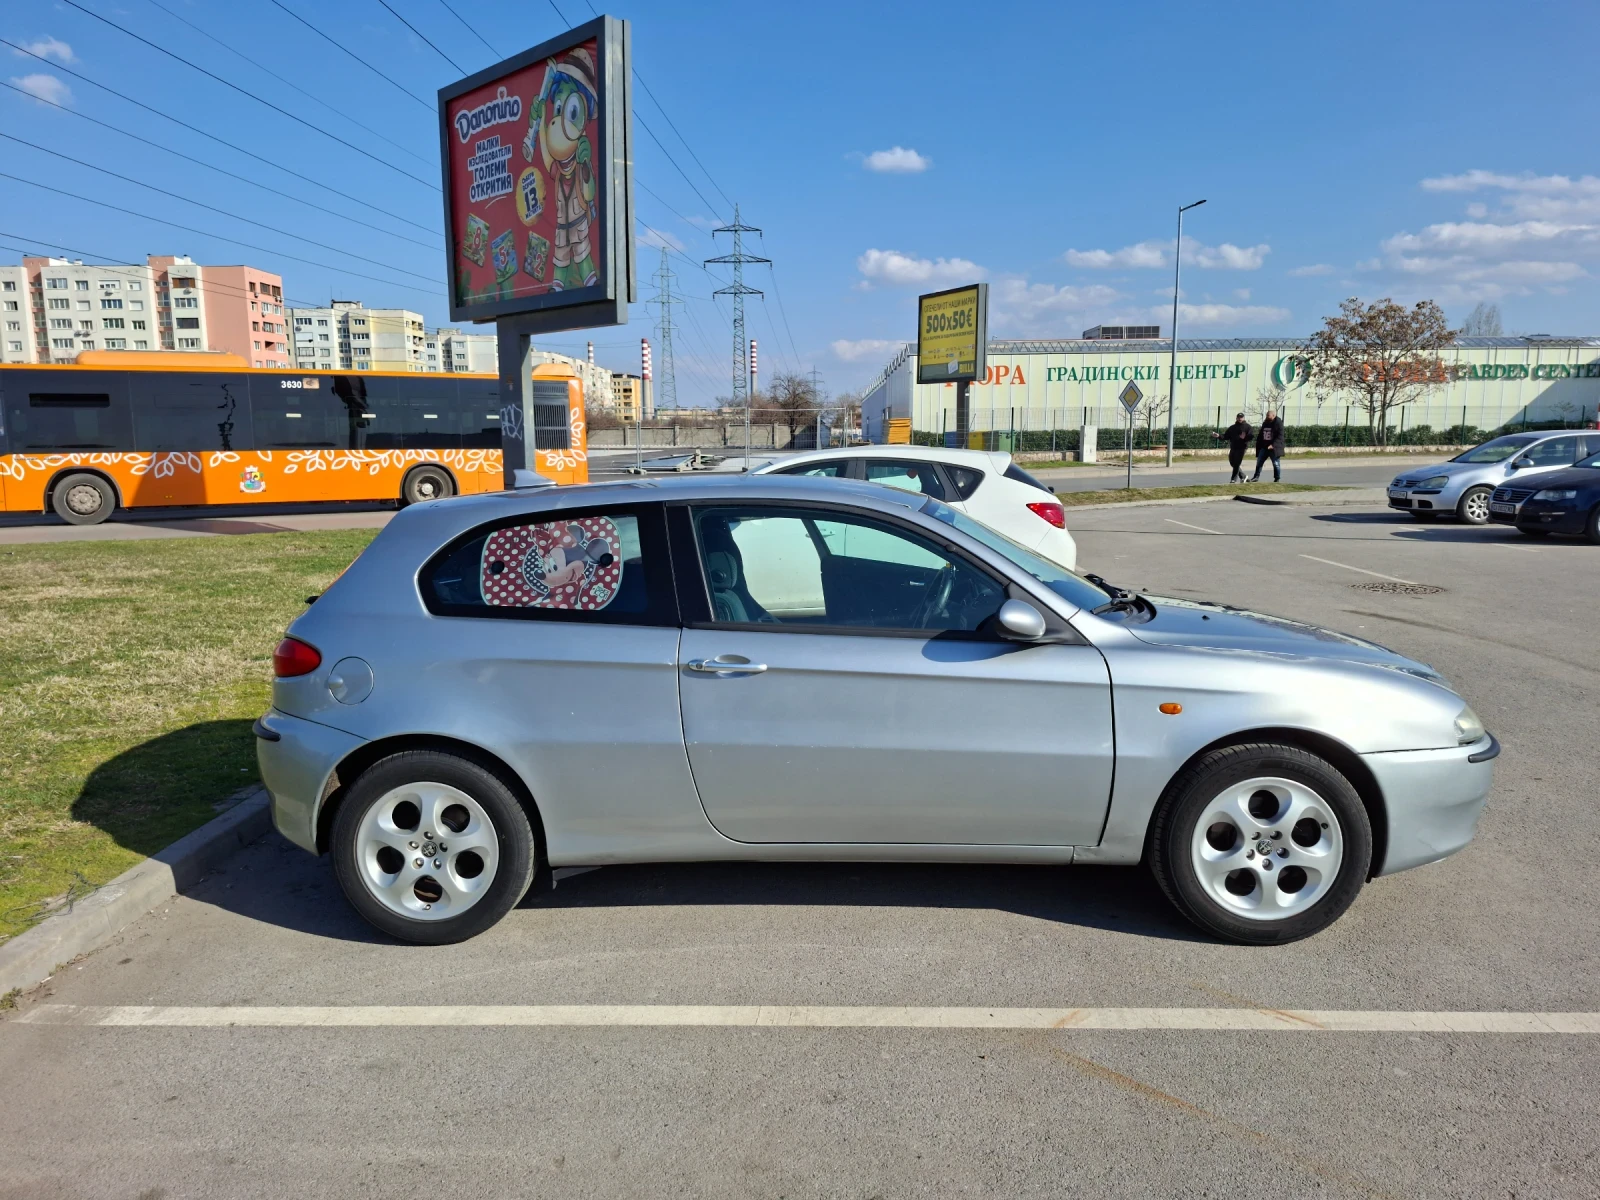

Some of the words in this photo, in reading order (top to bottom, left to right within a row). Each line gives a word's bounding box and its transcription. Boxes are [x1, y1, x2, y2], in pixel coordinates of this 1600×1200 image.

[456, 91, 521, 142] Danonino
[476, 136, 500, 154] МАЛКИ
[468, 147, 512, 168] ИЗСЛЕДОВАТЕЛИ
[474, 159, 507, 182] ГОЛЕМИ
[470, 174, 512, 200] ОТКРИТИЯ
[525, 187, 539, 212] 13
[473, 227, 482, 249] 8
[498, 245, 508, 267] 5
[534, 252, 544, 277] 2
[1046, 366, 1160, 384] ГРАДИНСКИ
[1169, 364, 1246, 383] ЦЕНТЪР
[1456, 364, 1531, 379] GARDEN
[281, 380, 302, 389] 3630
